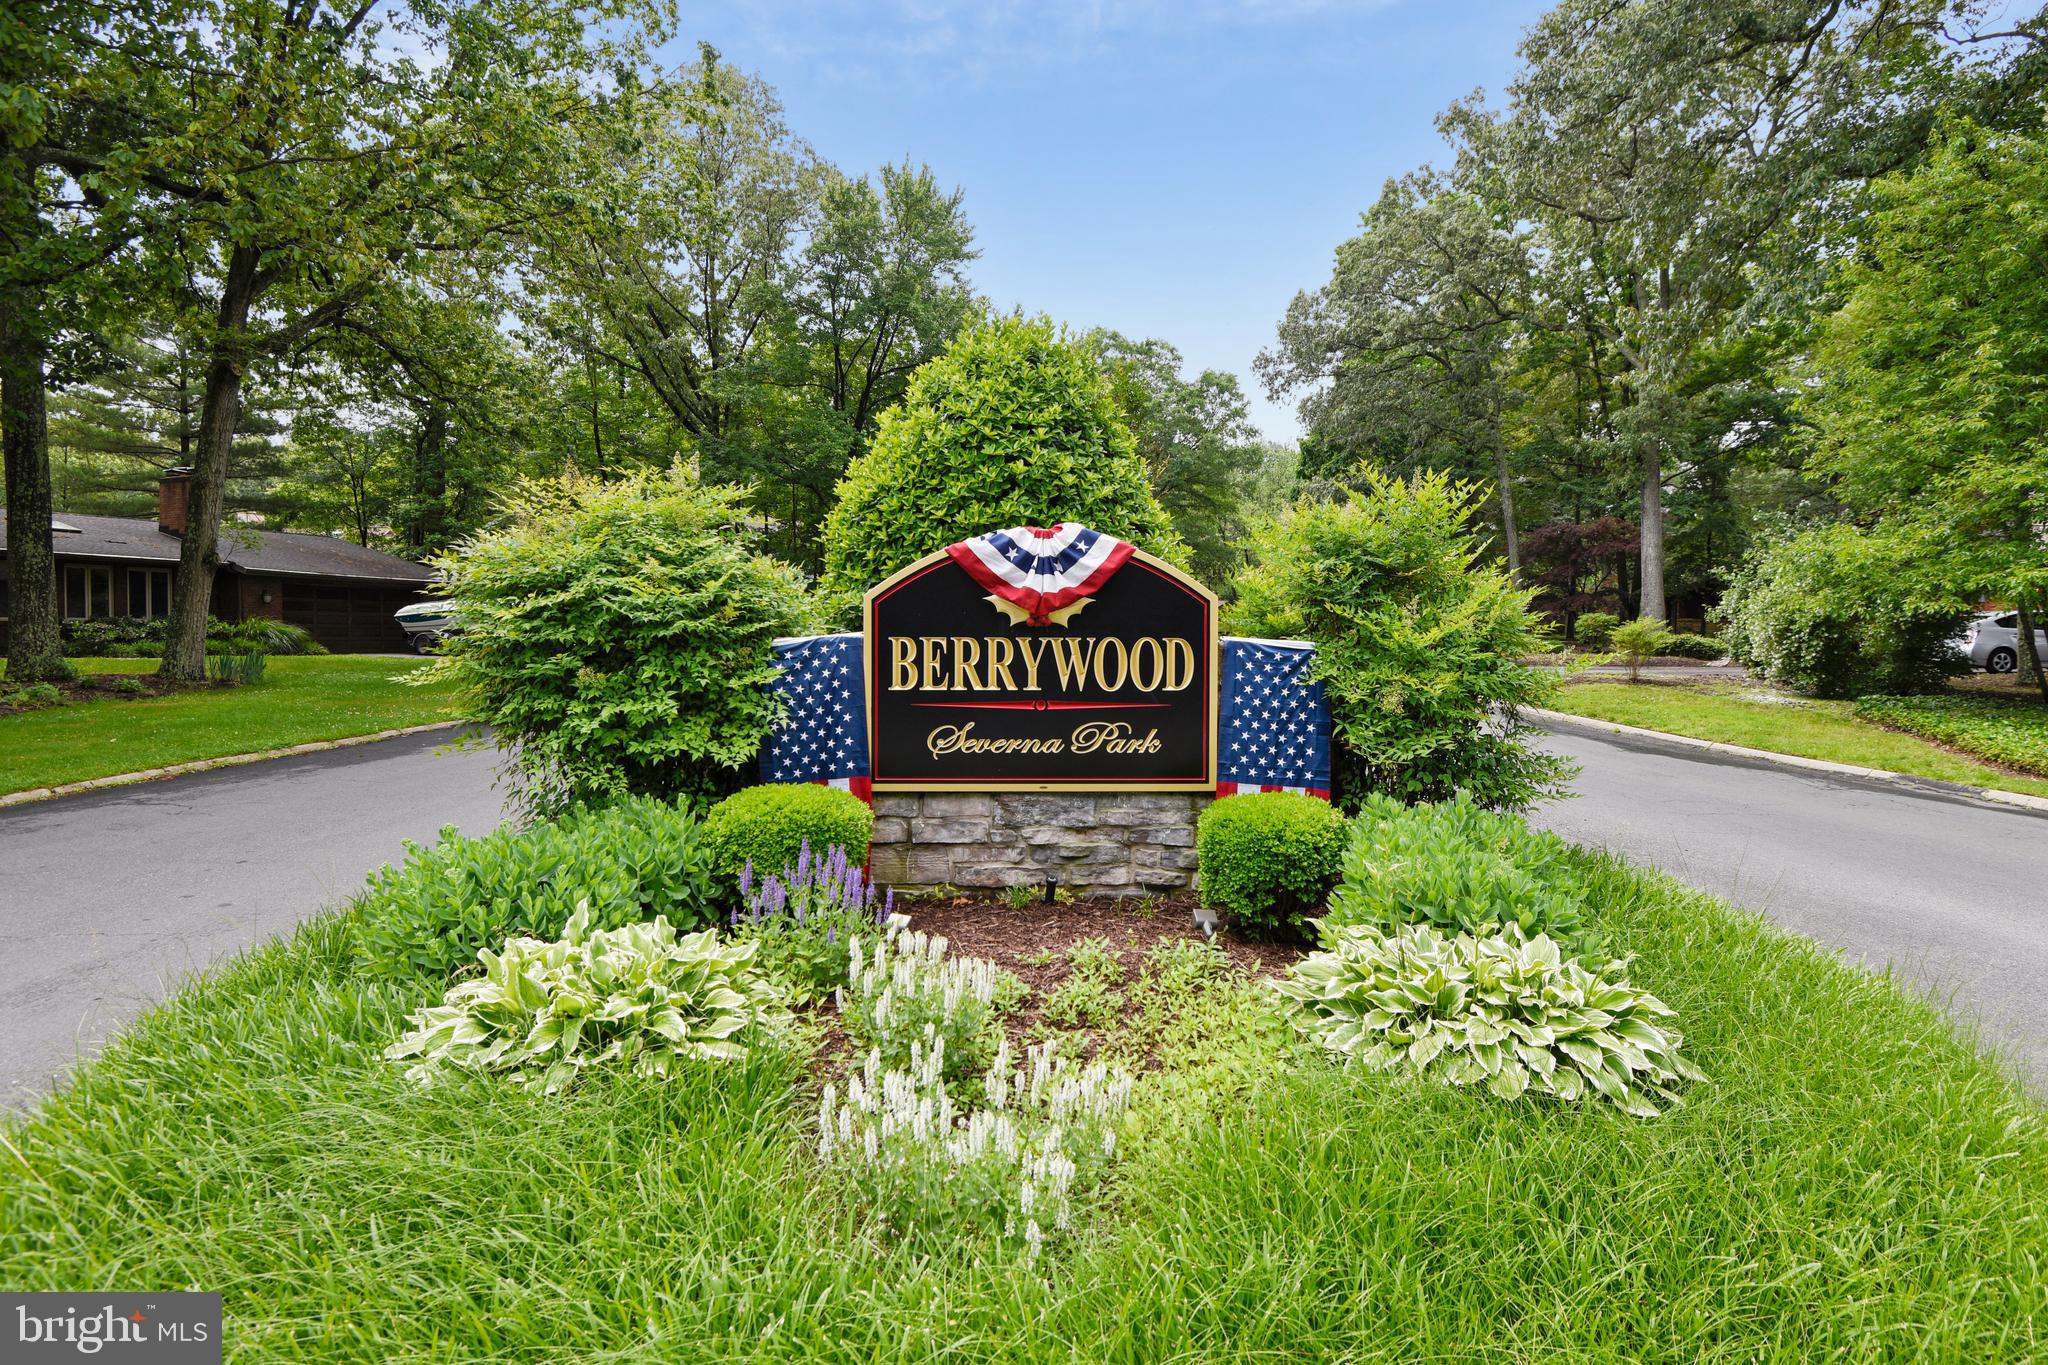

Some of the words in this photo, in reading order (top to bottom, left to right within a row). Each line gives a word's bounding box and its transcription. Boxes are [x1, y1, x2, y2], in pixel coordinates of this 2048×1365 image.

[888, 636, 1195, 692] BERRYWOOD
[927, 722, 1065, 760] Severna
[1070, 721, 1162, 754] Park
